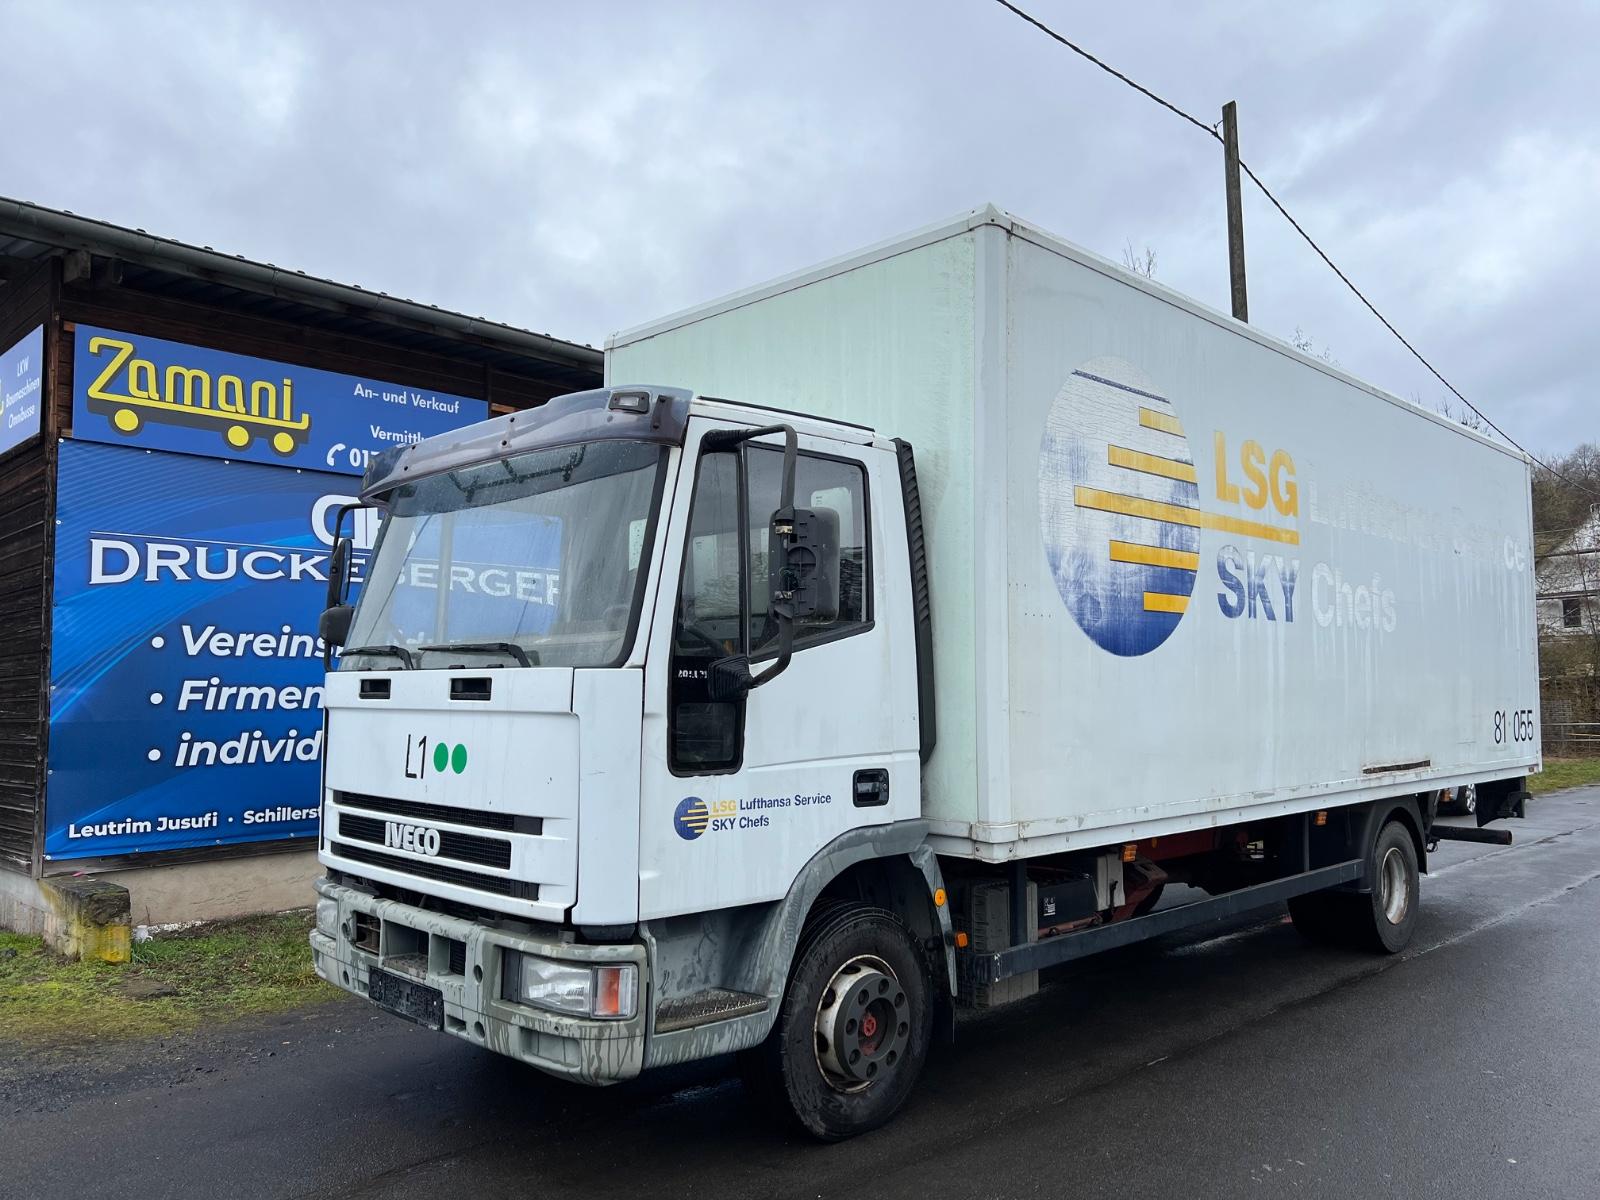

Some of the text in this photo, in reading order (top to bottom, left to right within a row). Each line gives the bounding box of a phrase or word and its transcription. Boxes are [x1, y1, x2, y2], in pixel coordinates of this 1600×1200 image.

[17, 356, 30, 377] LKW
[88, 337, 309, 430] Zamani
[354, 383, 459, 414] An- und Verkauf
[350, 448, 380, 468] 01
[1214, 430, 1299, 517] LSG
[1217, 545, 1300, 623] SKY
[1494, 709, 1534, 744] 81 055
[712, 792, 832, 813] LSG Lufthansa Service
[68, 818, 151, 839] Leutrim
[156, 812, 218, 832] Jusufi
[384, 821, 441, 857] IVECO
[712, 815, 769, 832] SKY Chefs
